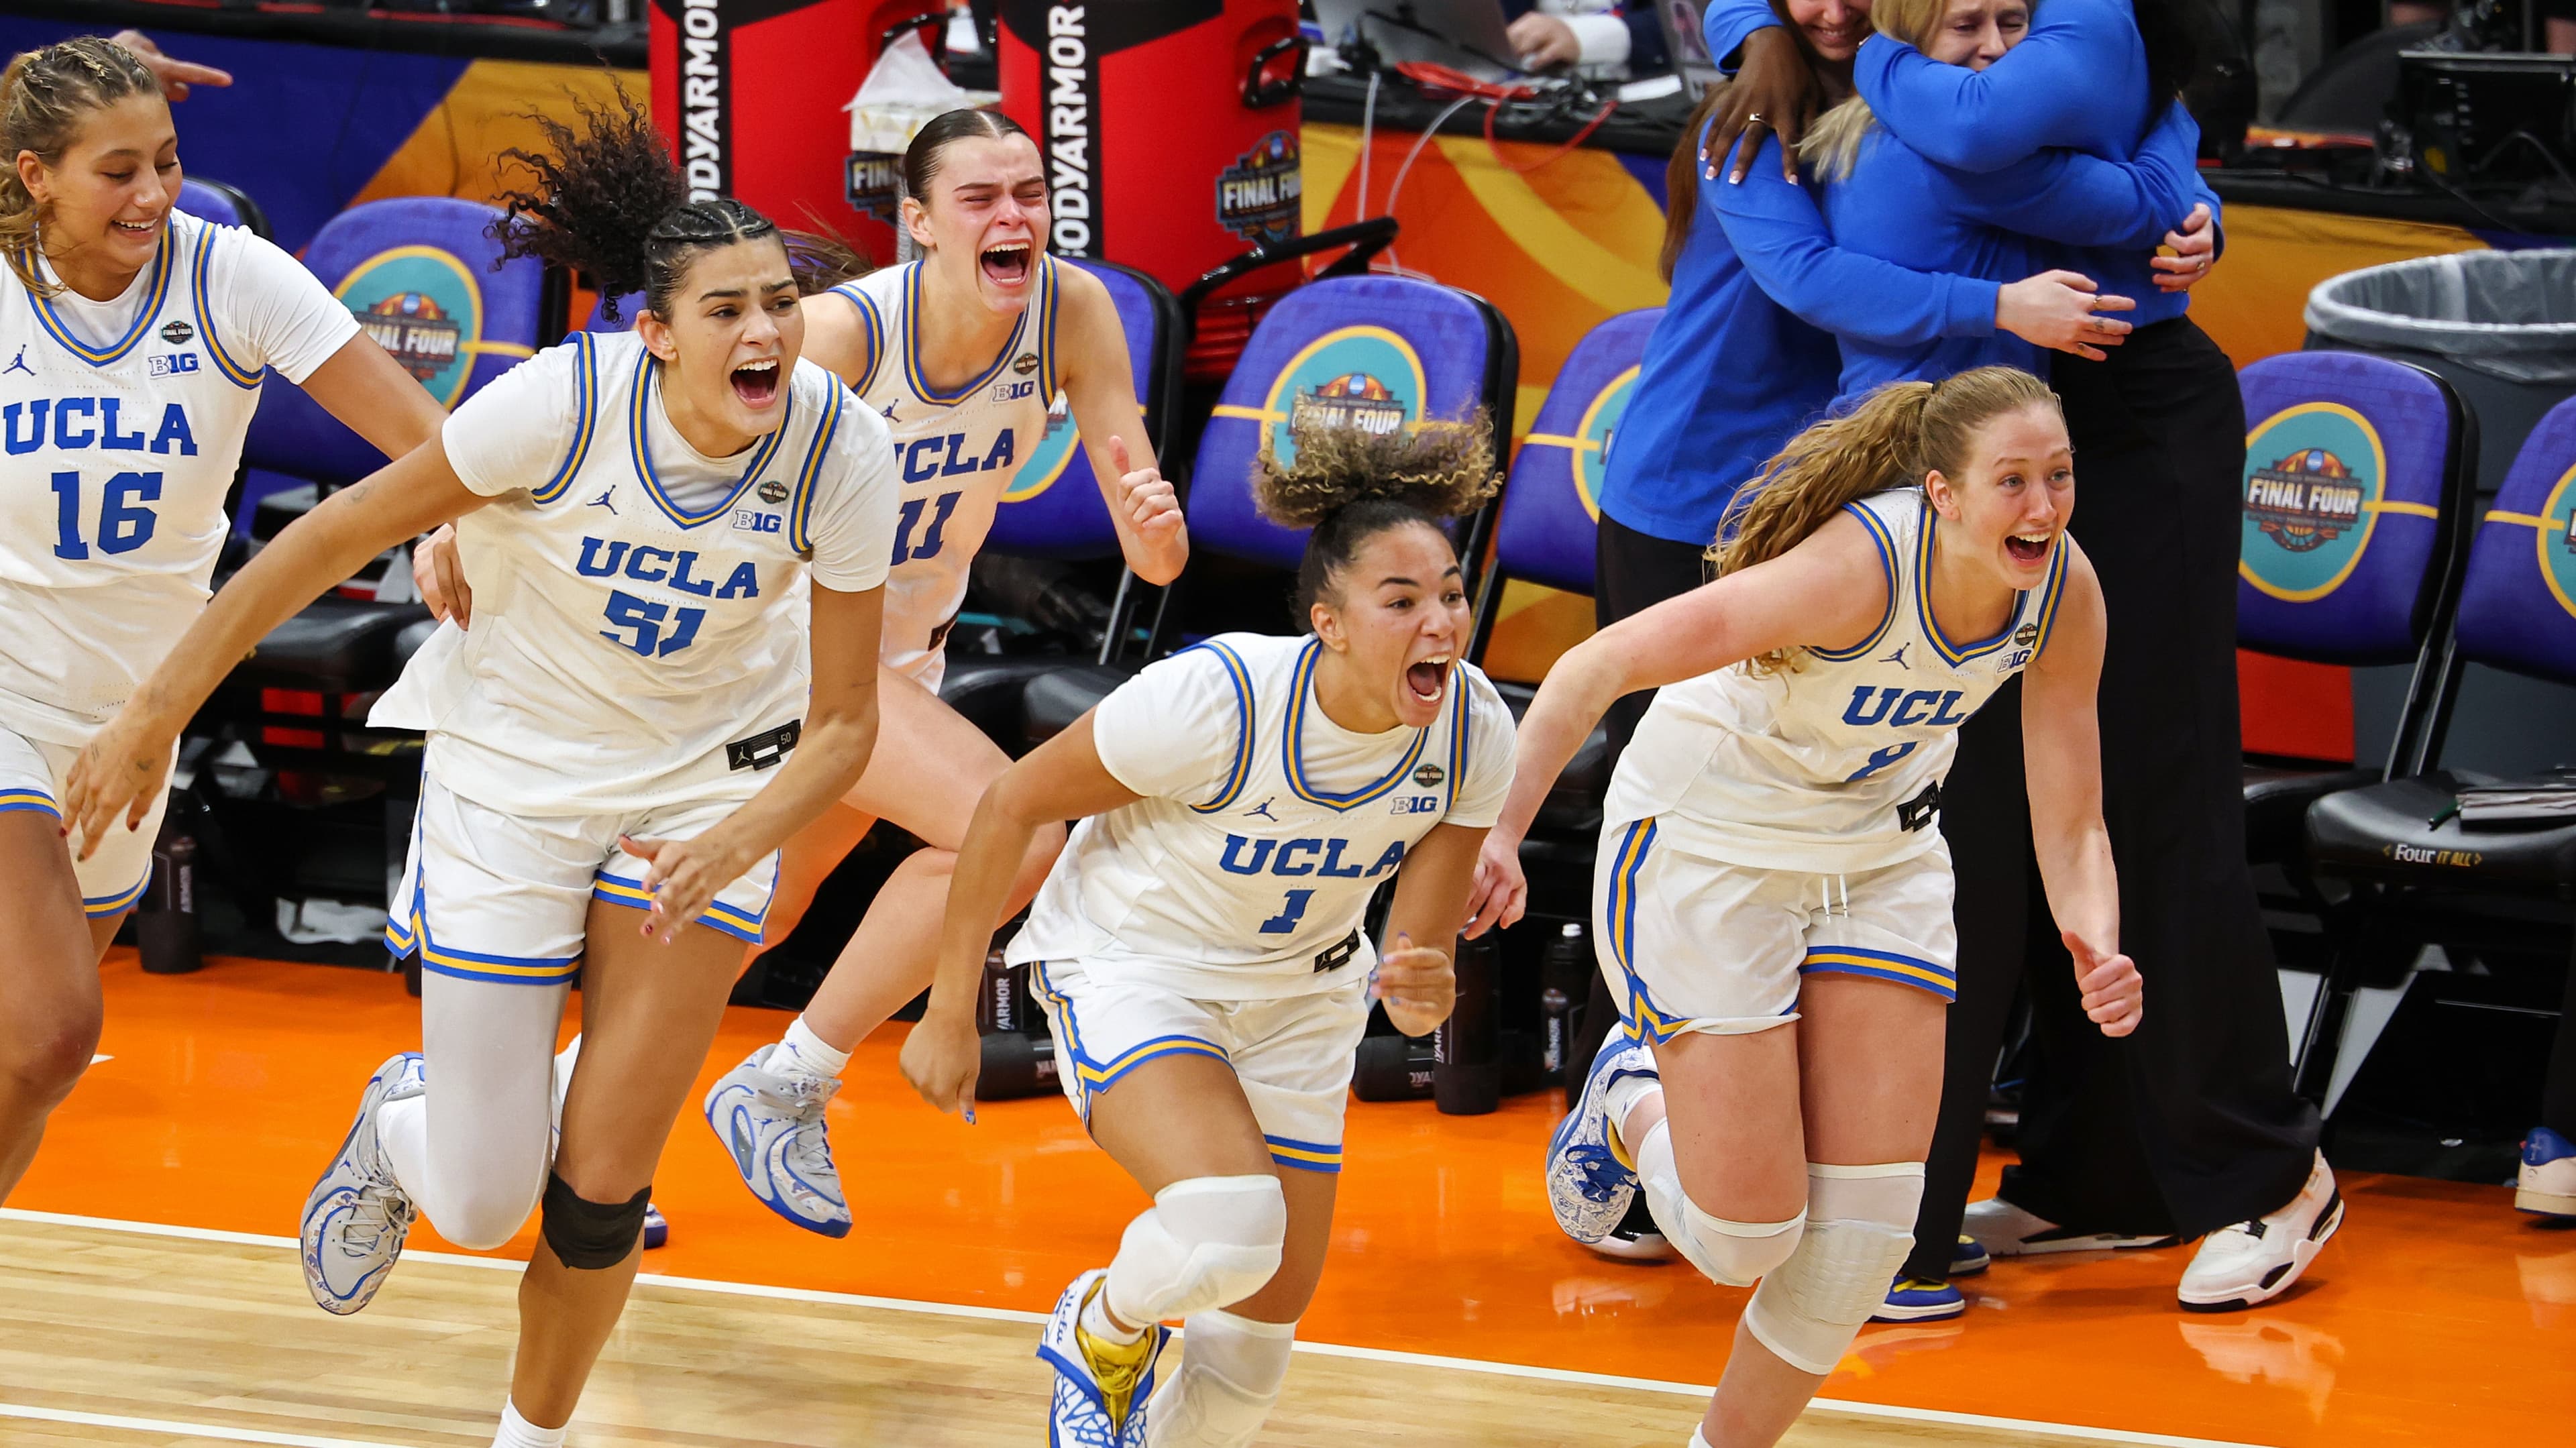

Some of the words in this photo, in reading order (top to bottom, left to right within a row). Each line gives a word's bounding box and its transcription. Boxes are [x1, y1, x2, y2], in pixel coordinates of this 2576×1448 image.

[684, 0, 720, 203] DYARMO
[1048, 5, 1090, 258] ODYARMOR
[1223, 176, 1278, 210] FINAL
[405, 327, 458, 355] FOUR
[3, 397, 198, 456] UCLA
[1353, 408, 1403, 435] FOUR
[51, 471, 163, 560] 16
[2247, 478, 2304, 510] FINAL
[2308, 485, 2360, 514] FOUR
[890, 491, 963, 566] 11
[576, 536, 759, 599] UCLA
[599, 589, 706, 658] 51
[1842, 685, 1969, 727] UCL
[781, 732, 792, 744] 50
[1219, 833, 1405, 878] UCLA
[2394, 842, 2436, 864] Four
[2436, 850, 2451, 865] IT
[2451, 851, 2471, 867] ALL
[1258, 889, 1316, 934] 1
